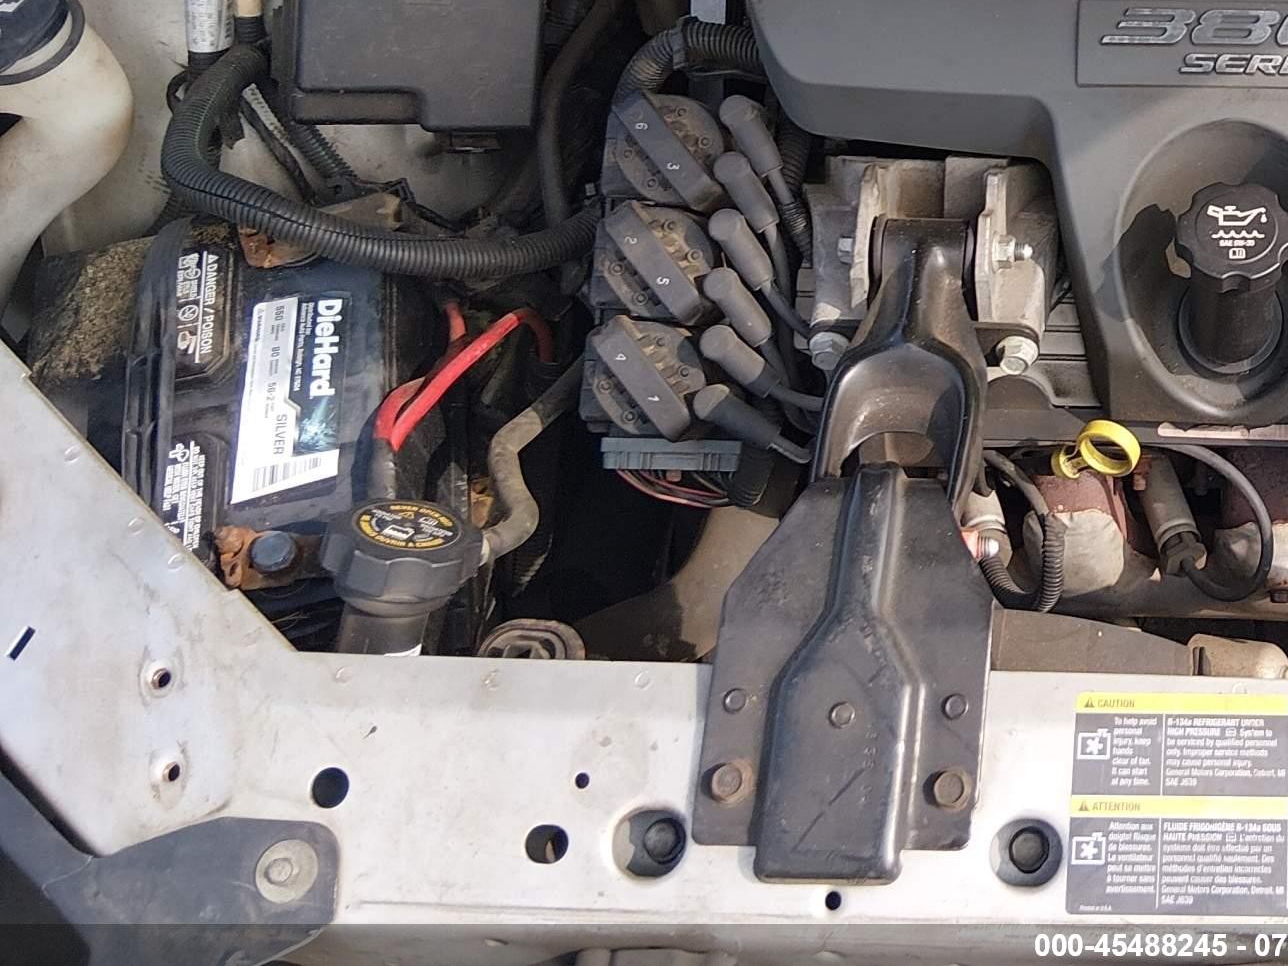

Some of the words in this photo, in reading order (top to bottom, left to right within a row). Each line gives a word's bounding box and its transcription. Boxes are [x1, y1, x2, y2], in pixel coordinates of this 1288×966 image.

[667, 162, 680, 170] 3
[625, 236, 637, 245] 2
[204, 264, 218, 305] DANGER
[656, 277, 669, 285] 5
[274, 305, 285, 321] 550
[200, 315, 214, 354] POISON
[309, 298, 342, 397] DieHard
[273, 414, 288, 455] SILVER
[1098, 699, 1135, 707] CAUTION
[1092, 802, 1140, 810] ATTENTION
